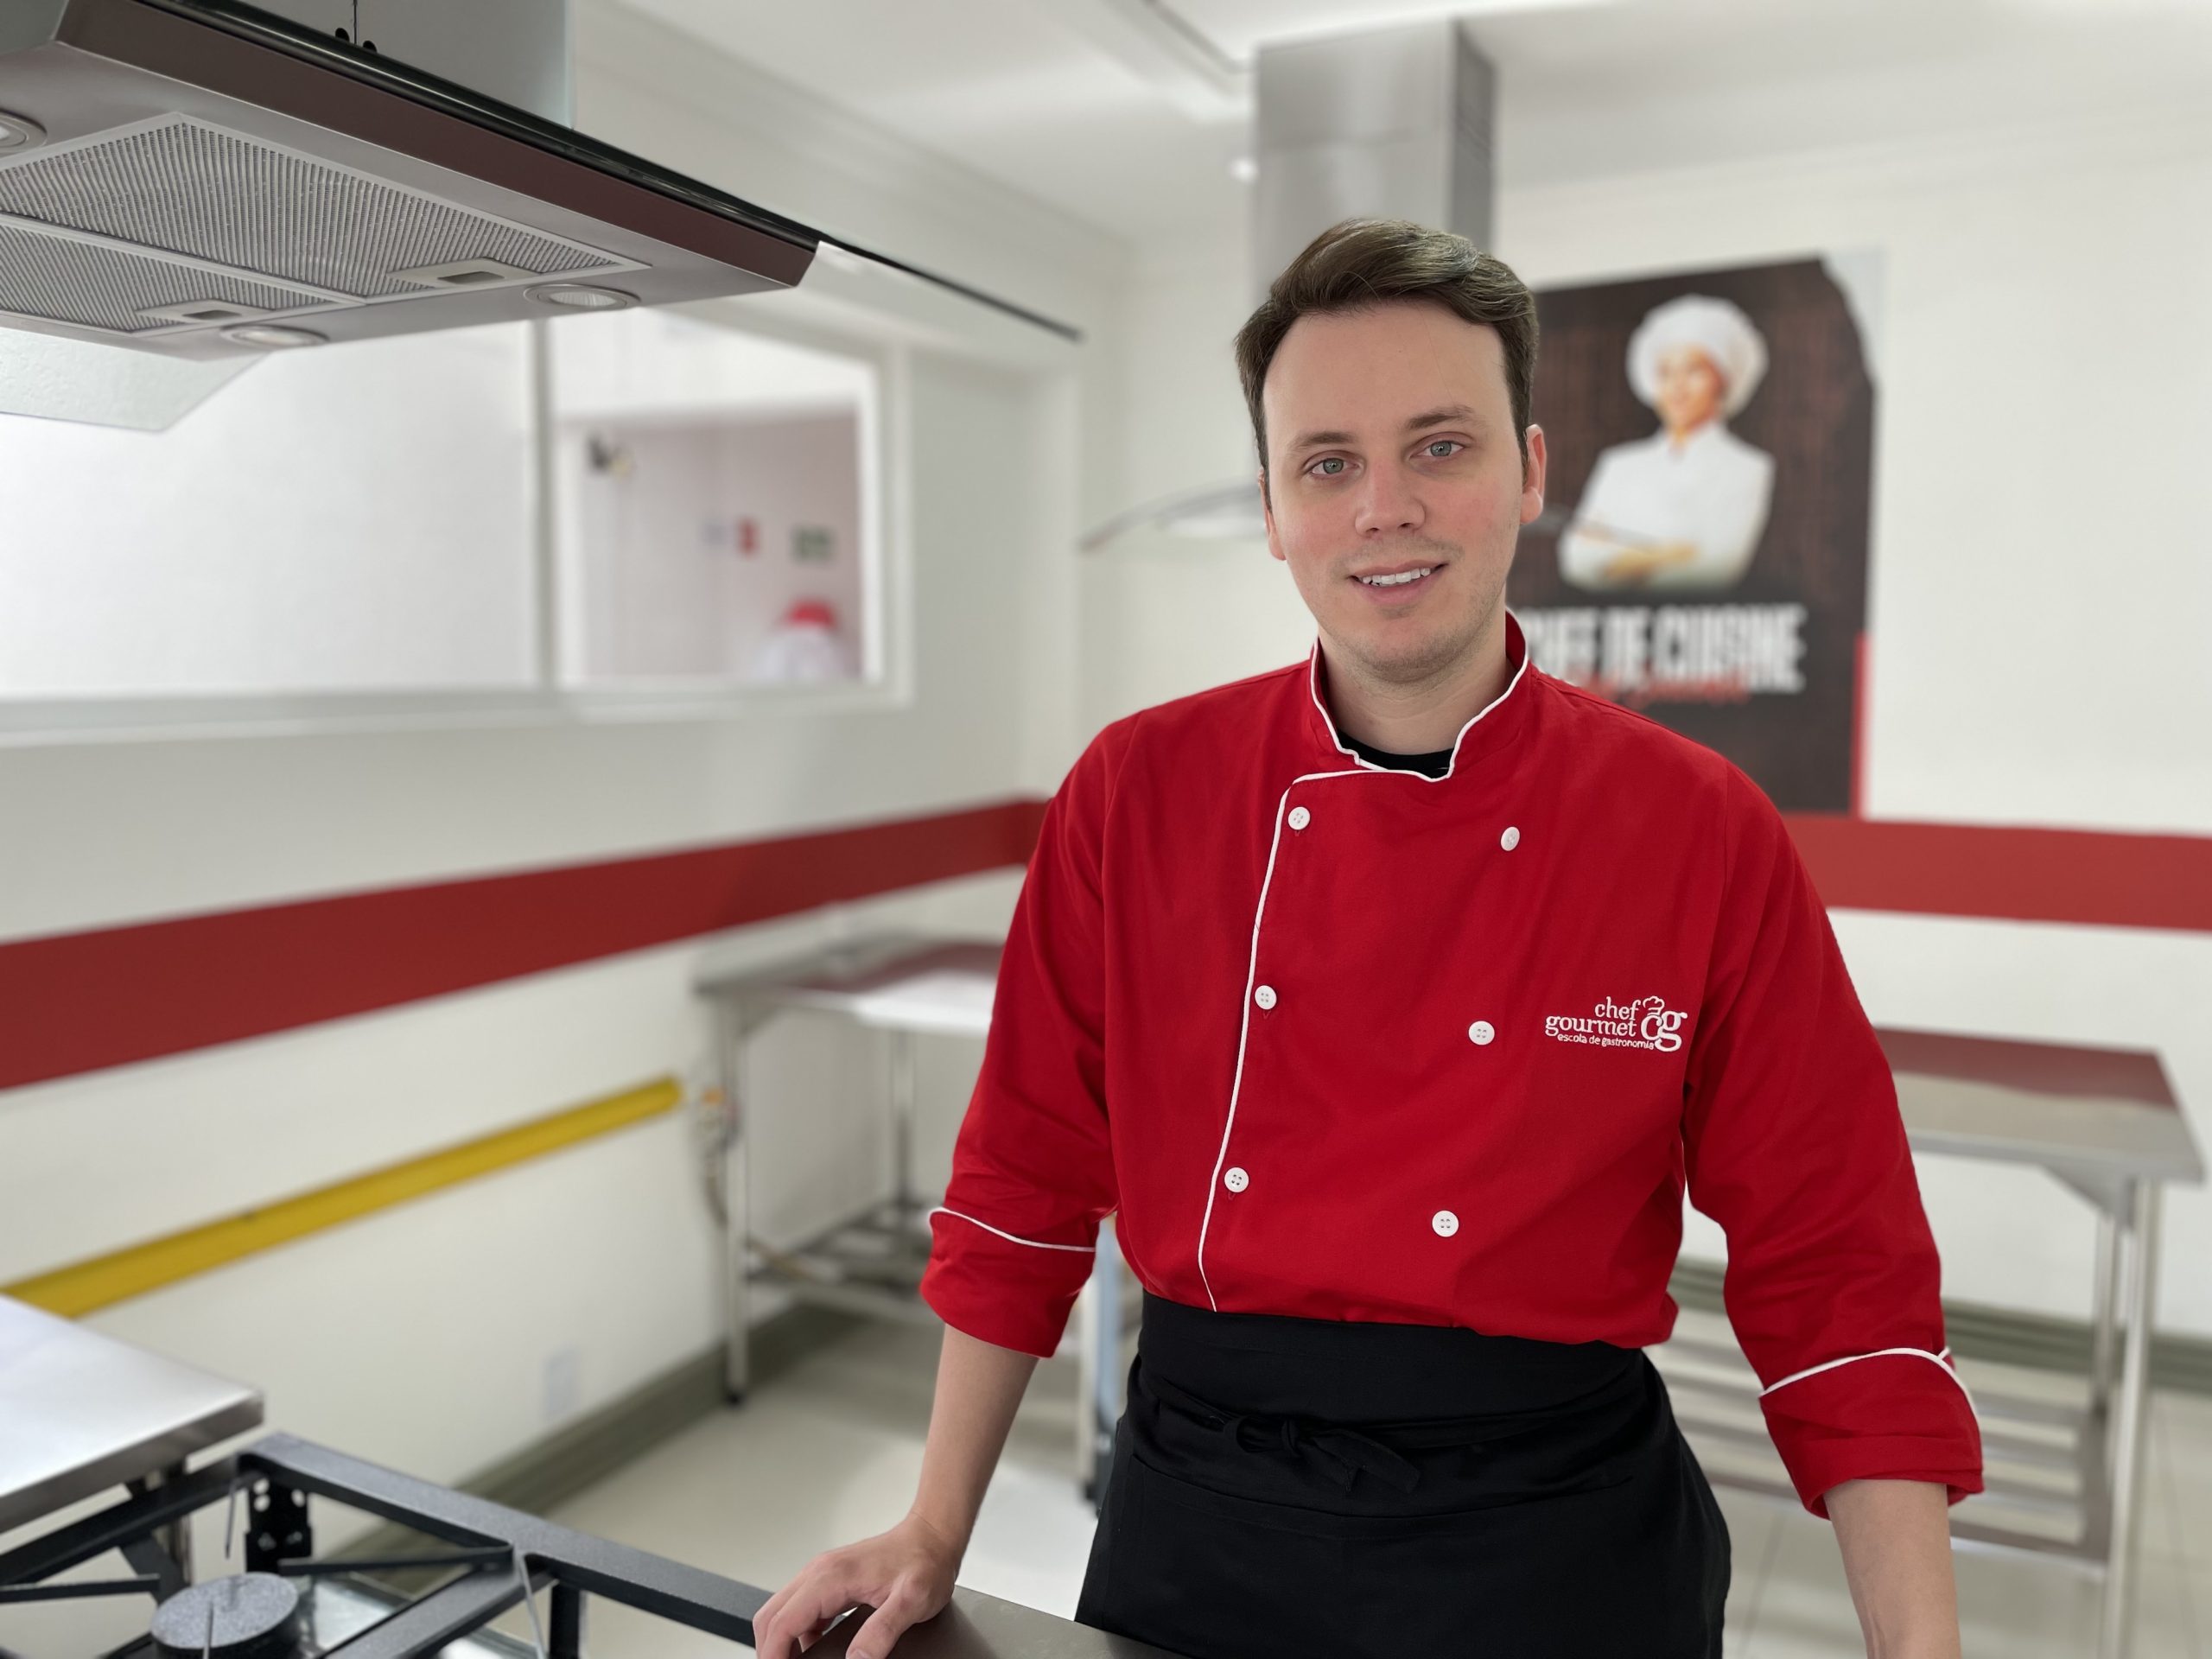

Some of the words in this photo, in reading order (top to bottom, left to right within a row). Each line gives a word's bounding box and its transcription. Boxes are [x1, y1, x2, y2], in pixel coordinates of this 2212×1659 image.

[1654, 603, 1806, 692] CUISINE
[1594, 996, 1641, 1020] chef
[1545, 1014, 1637, 1037] gourmet
[1557, 1033, 1587, 1044] escola
[1589, 1034, 1601, 1045] de
[1601, 1037, 1655, 1050] gastronomia
